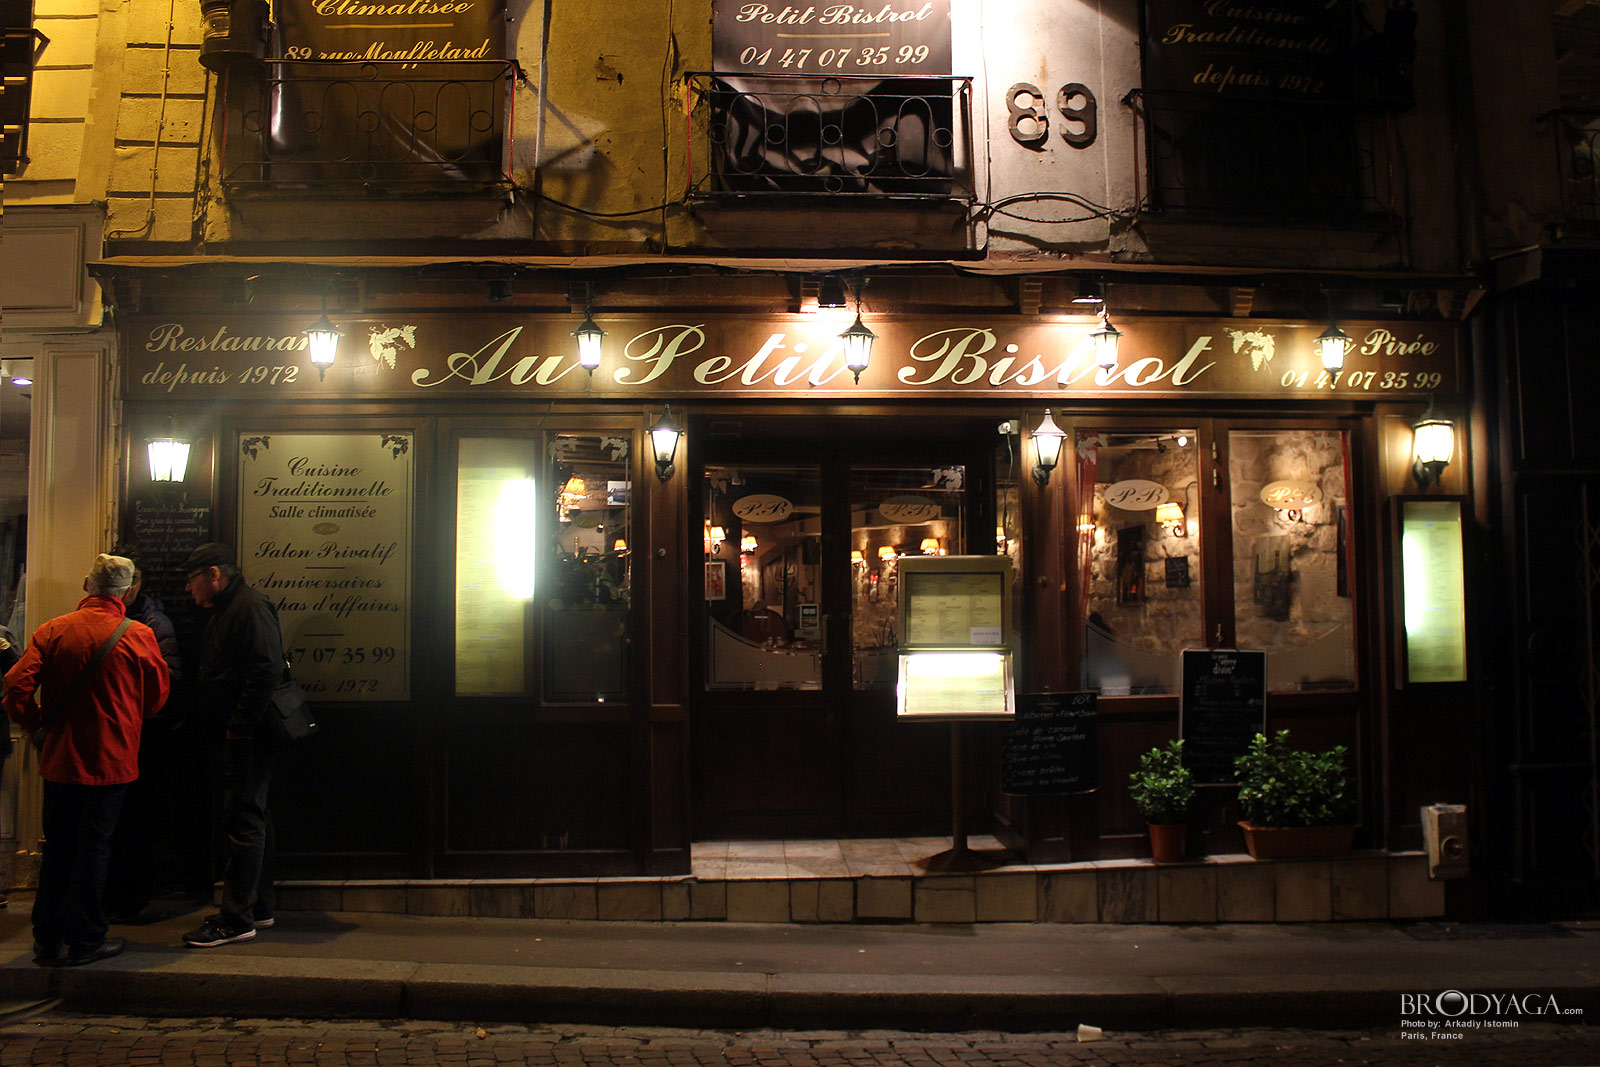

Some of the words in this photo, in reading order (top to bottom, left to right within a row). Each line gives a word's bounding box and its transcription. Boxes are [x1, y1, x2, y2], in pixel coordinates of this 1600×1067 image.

[311, 0, 475, 16] Climatisée
[736, 2, 818, 25] Petit
[818, 2, 934, 26] Bistrot
[284, 45, 312, 60] 89
[357, 38, 491, 69] Mouffetard
[739, 46, 773, 67] 01
[777, 47, 813, 69] 47
[818, 46, 849, 68] 07
[856, 45, 891, 66] 35
[896, 44, 930, 65] 99
[1193, 63, 1270, 93] depuis
[1279, 73, 1326, 94] 1972
[1006, 82, 1097, 148] 89
[1360, 328, 1440, 356] Pirée
[411, 325, 581, 388] Au
[613, 323, 848, 387] Petit
[897, 327, 1217, 387] Bistrot
[141, 362, 233, 393] depuis
[238, 365, 299, 385] 1972
[1280, 370, 1310, 388] 01
[1347, 371, 1377, 390] 07
[1379, 372, 1408, 389] 35
[1413, 372, 1442, 389] 99
[287, 456, 363, 477] Cuisine
[253, 477, 393, 497] Traditionnelle
[269, 506, 304, 519] Salle
[308, 505, 377, 519] climatisée
[255, 541, 314, 559] Salon
[317, 541, 397, 566] Privatif
[252, 572, 385, 589] Anniversaires
[313, 648, 335, 663] 07
[343, 647, 365, 664] 35
[372, 646, 395, 664] 99
[336, 679, 378, 693] 1972
